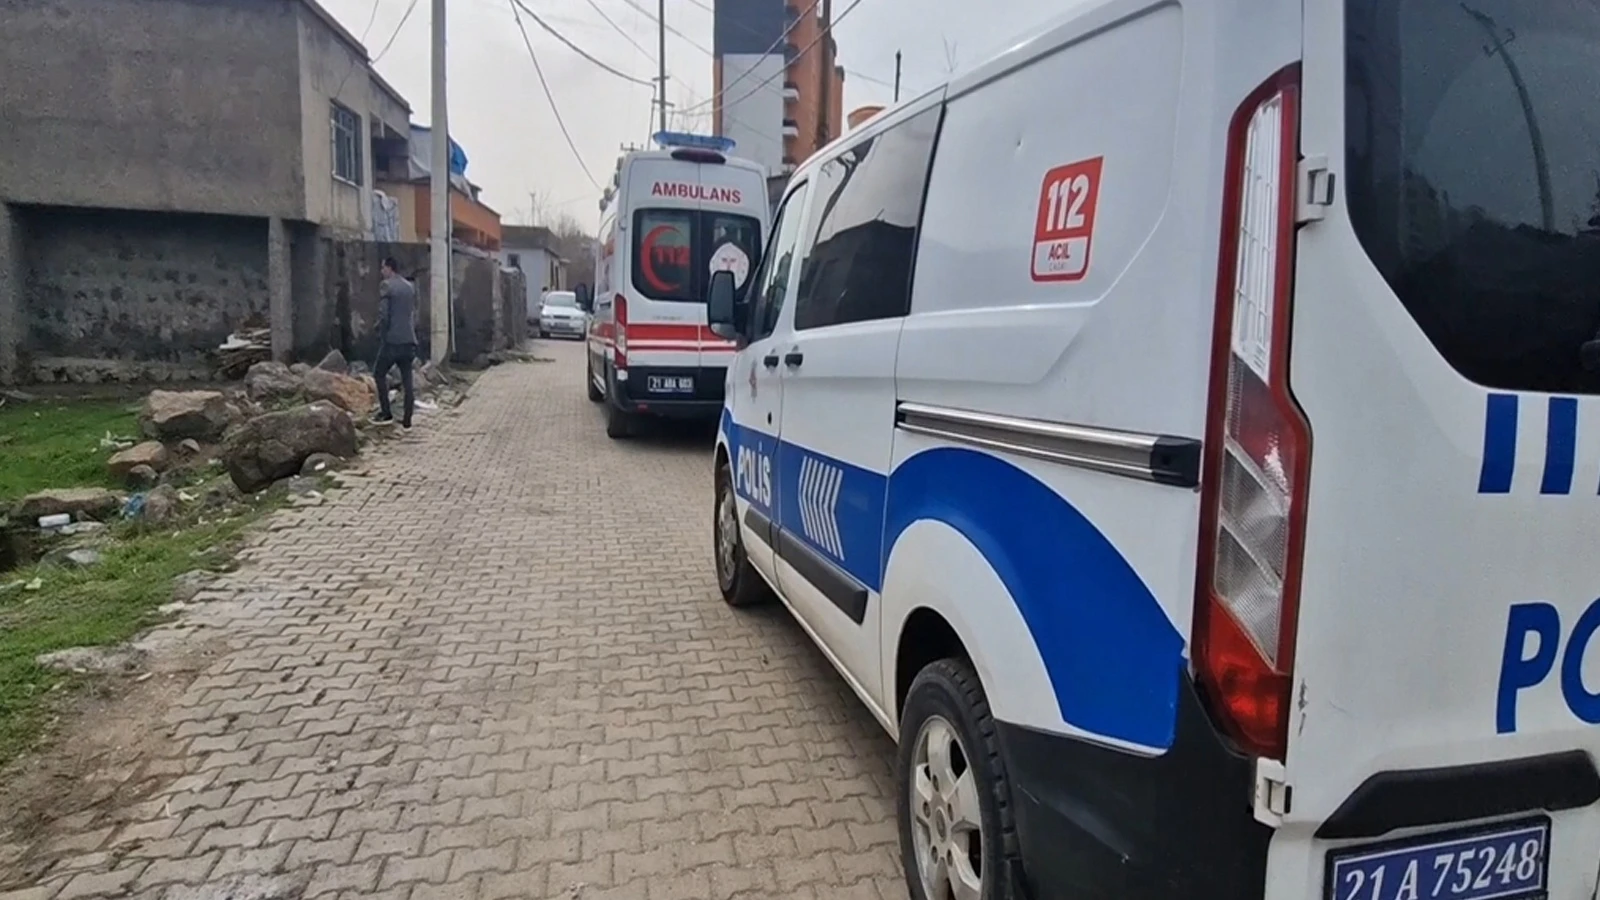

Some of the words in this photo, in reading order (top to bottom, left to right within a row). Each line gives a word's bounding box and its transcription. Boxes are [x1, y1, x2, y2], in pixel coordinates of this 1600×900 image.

[652, 181, 742, 204] AMBULANS
[1046, 174, 1089, 232] 112
[656, 246, 690, 266] 112
[737, 441, 770, 507] POLİS
[1345, 864, 1386, 900] 21
[1394, 859, 1419, 900] A
[1431, 839, 1540, 897] 75248
